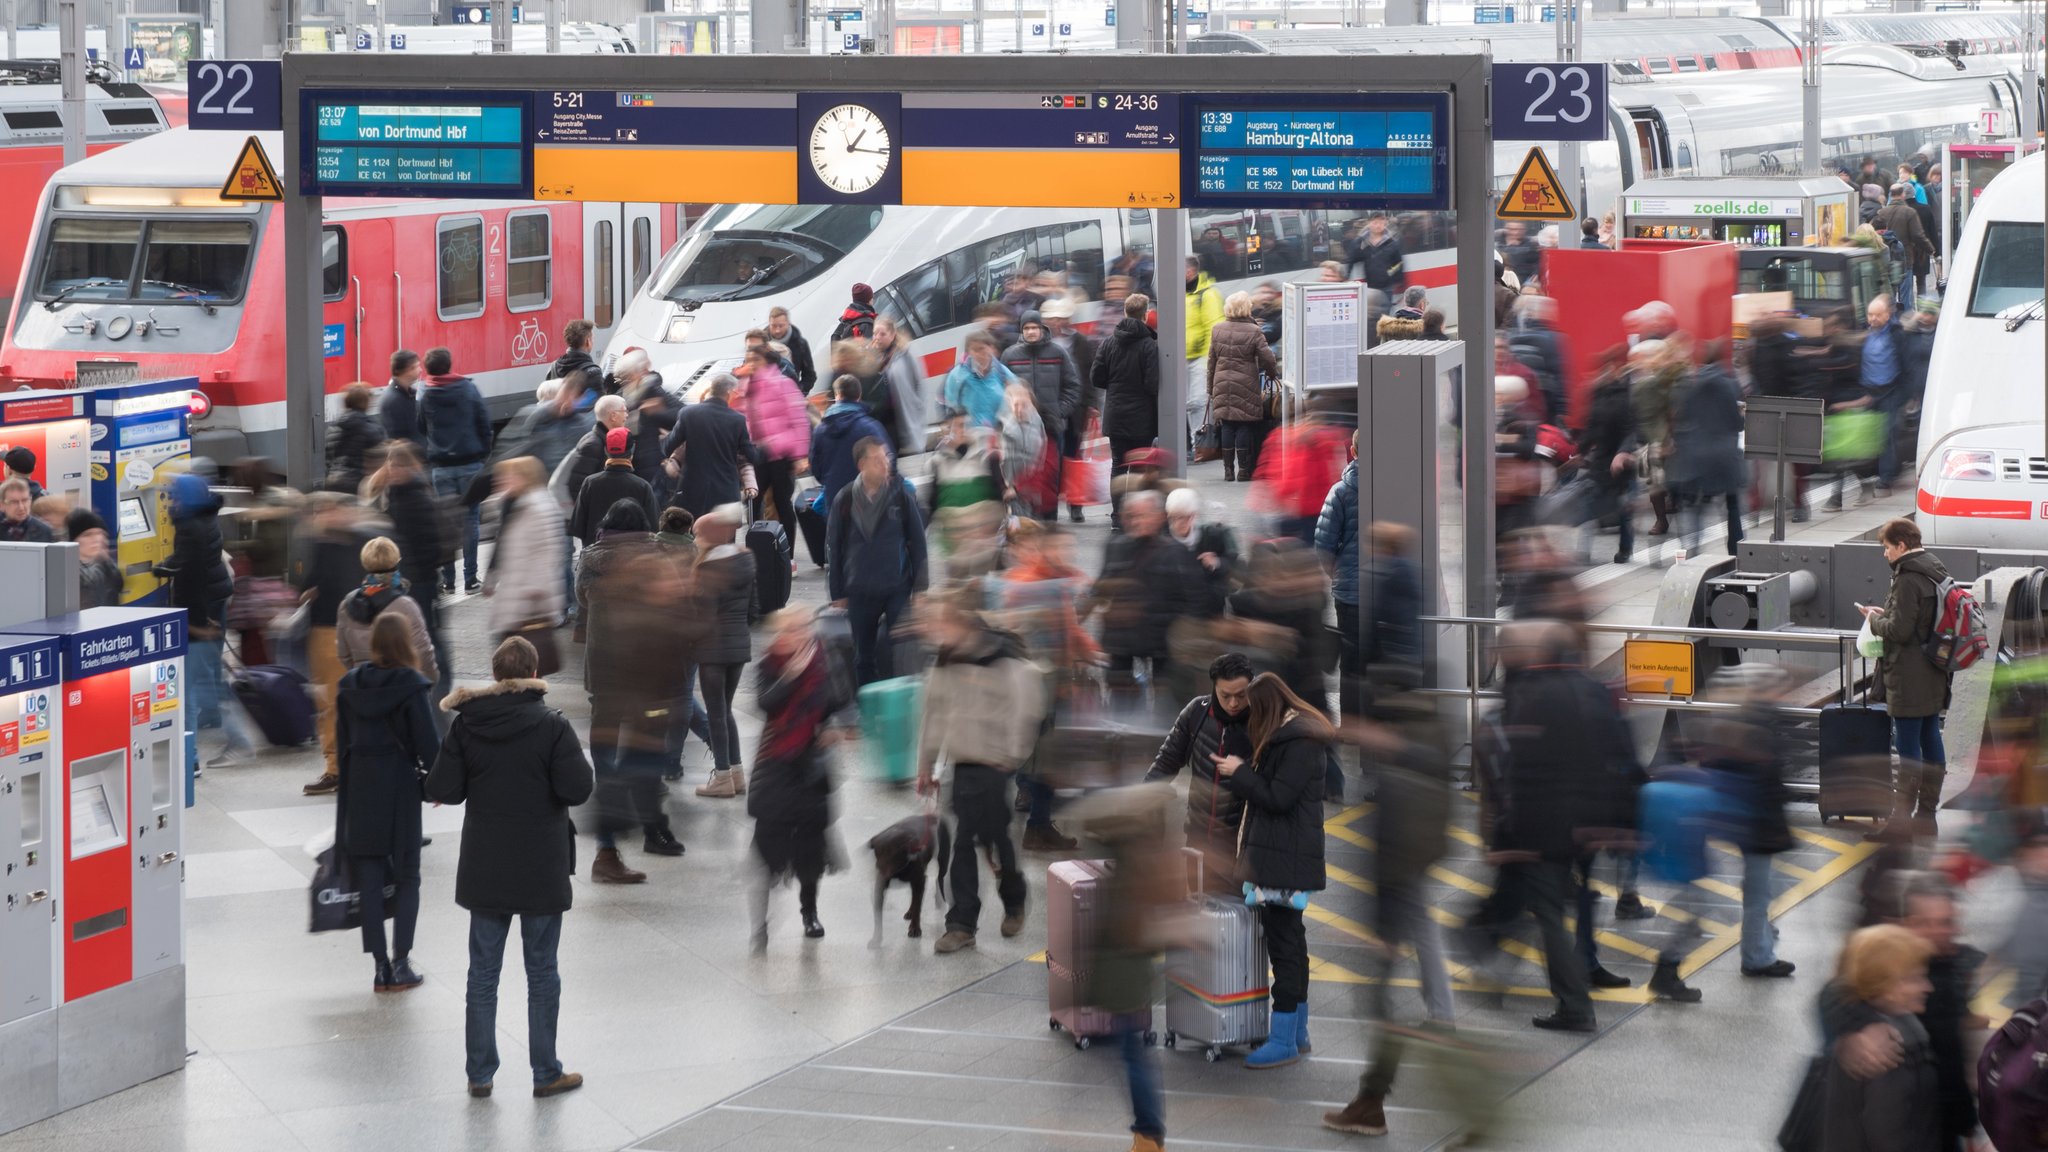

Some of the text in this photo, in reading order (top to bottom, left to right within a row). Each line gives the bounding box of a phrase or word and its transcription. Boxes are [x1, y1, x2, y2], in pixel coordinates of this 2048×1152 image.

[457, 13, 466, 23] 11
[1033, 24, 1041, 34] C
[1062, 24, 1070, 34] C
[357, 34, 366, 47] B
[395, 35, 403, 47] B
[845, 34, 854, 47] B
[129, 49, 141, 65] A
[196, 63, 254, 114] 22
[553, 92, 583, 108] 5-21
[623, 94, 631, 105] U
[1523, 66, 1593, 123] 23
[1098, 96, 1109, 108] S
[1114, 94, 1159, 110] 24-36
[320, 107, 346, 118] 13:07
[553, 113, 575, 121] Ausgang
[1202, 112, 1233, 124] 13:39
[1135, 124, 1158, 132] Ausgang
[1247, 122, 1278, 131] Augsburg
[1291, 122, 1322, 131] Nürnberg
[1323, 122, 1335, 130] Hbf
[1981, 112, 1999, 134] T
[359, 125, 467, 139] von Dortmund Hbf
[1202, 125, 1212, 133] ICE
[1246, 131, 1354, 149] Hamburg-Altona
[318, 157, 339, 166] 13:54
[358, 158, 390, 167] ICE 1124
[398, 157, 453, 168] Dortmund Hbf
[318, 169, 340, 179] 14:07
[358, 171, 386, 180] ICE 621
[398, 170, 471, 181] von Dortmund Hbf
[1200, 166, 1225, 176] 14:41
[1246, 167, 1278, 176] ICE 585
[1292, 166, 1363, 177] von Lübeck Hbf
[1200, 179, 1225, 189] 16:16
[1246, 181, 1283, 190] ICE 1522
[1291, 180, 1355, 190] Dortmund Hbf
[1694, 200, 1769, 214] zoells.de
[489, 224, 501, 254] 2
[80, 635, 133, 658] Fahrkarten
[1657, 664, 1689, 673] Aufenthalt!
[168, 682, 176, 696] S
[39, 714, 47, 727] S
